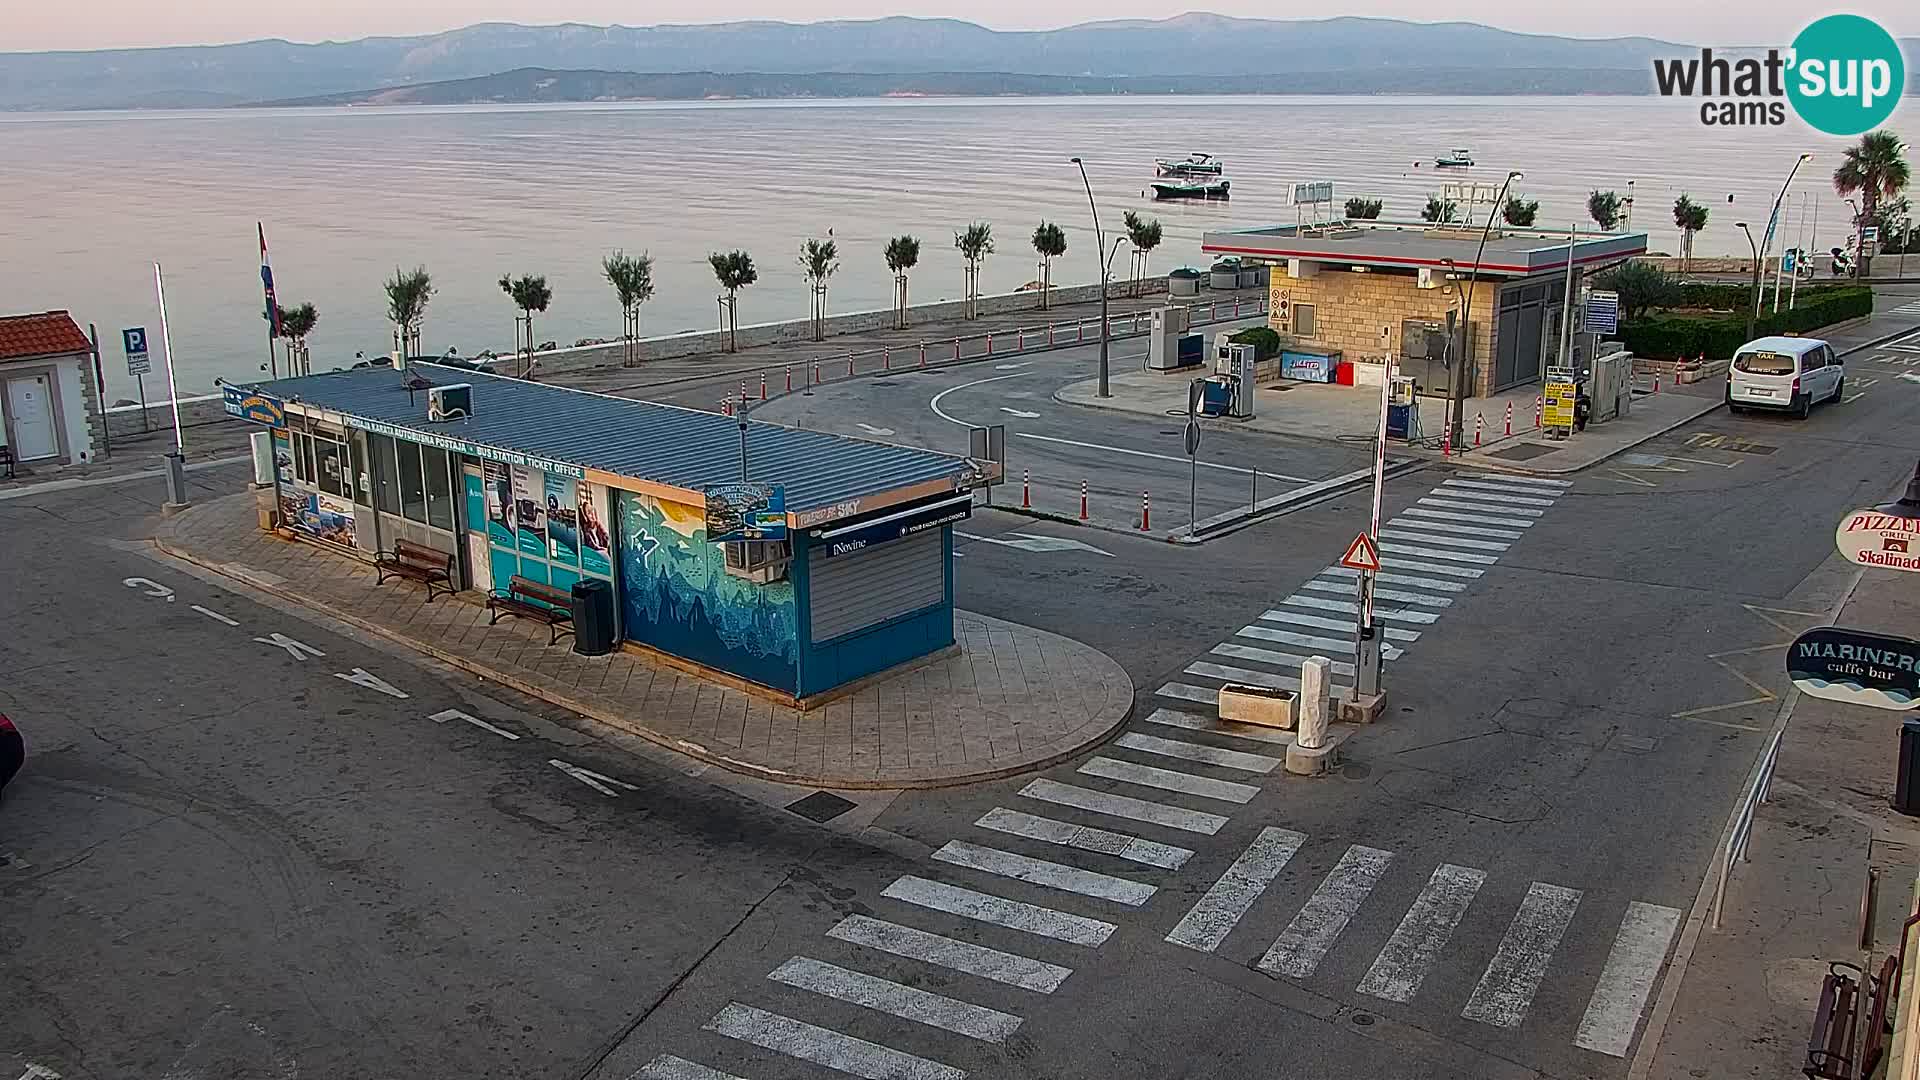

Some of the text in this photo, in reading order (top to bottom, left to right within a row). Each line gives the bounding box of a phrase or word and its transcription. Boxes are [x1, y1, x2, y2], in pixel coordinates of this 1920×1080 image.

[128, 332, 141, 350] P
[345, 416, 370, 431] PRODAJA
[371, 423, 394, 436] KARATA
[394, 427, 435, 445] AUTOBUSNA
[435, 437, 467, 453] POSTAJA
[477, 447, 492, 458] BUS
[493, 450, 525, 466] STATION
[526, 457, 553, 472] TICKET
[554, 461, 581, 478] OFFICE
[1880, 531, 1916, 541] GRILL
[1827, 662, 1896, 681] caffe bar
